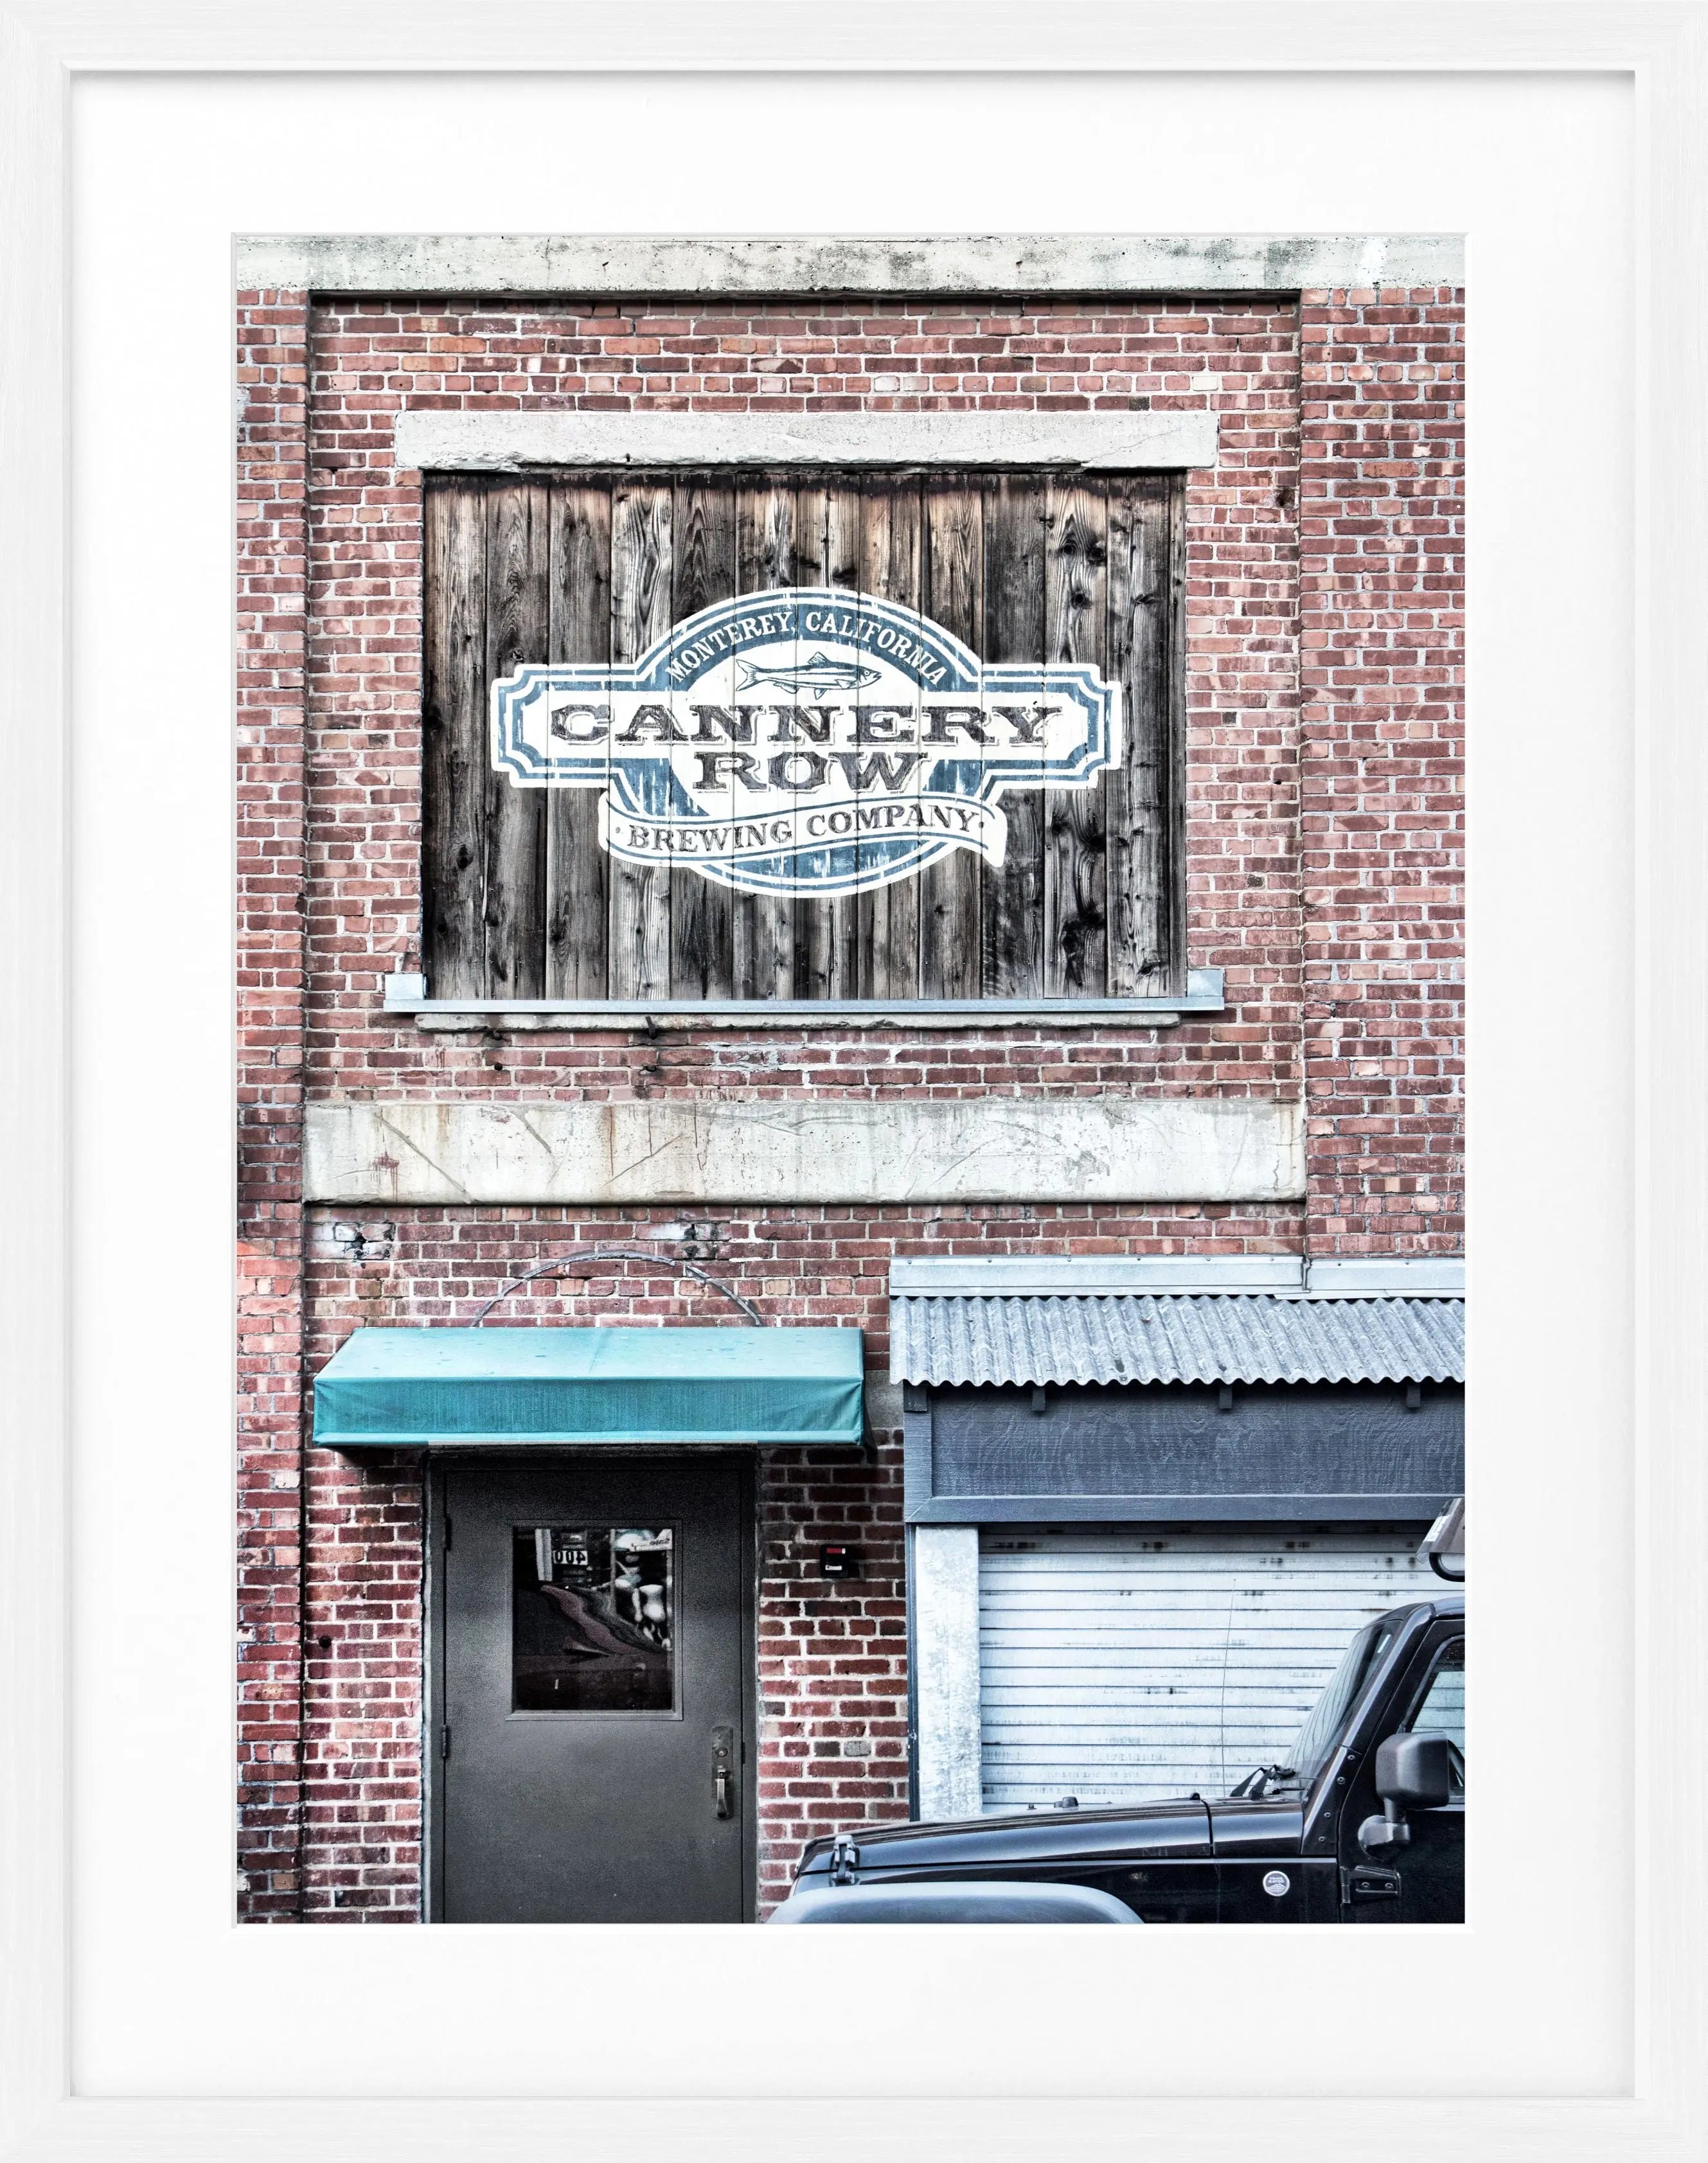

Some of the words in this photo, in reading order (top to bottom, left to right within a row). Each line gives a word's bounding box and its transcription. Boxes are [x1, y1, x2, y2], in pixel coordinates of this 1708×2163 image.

[664, 611, 796, 683] MONTEREY,
[805, 611, 947, 685] CALIFORNIA
[551, 704, 1062, 746] CANNERY
[692, 751, 931, 794] ROW
[627, 819, 792, 853] BREWING
[806, 803, 980, 837] COMPANY
